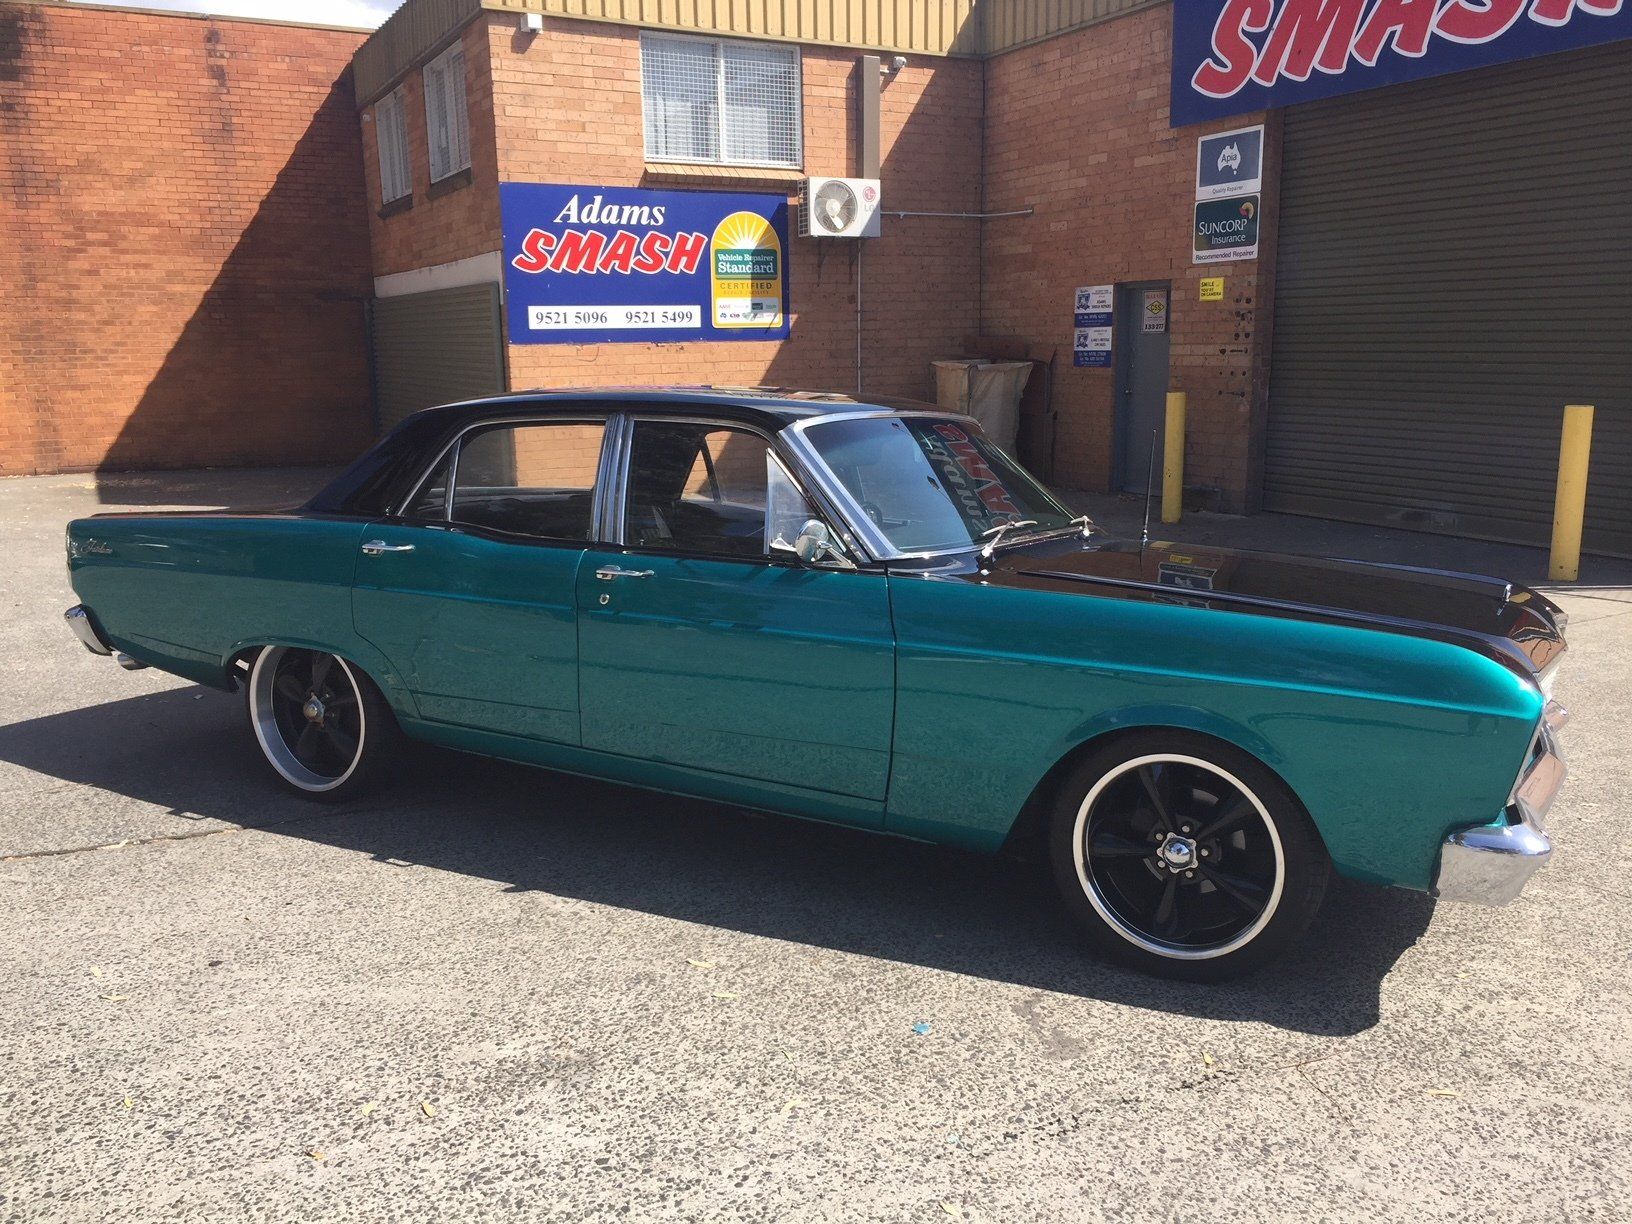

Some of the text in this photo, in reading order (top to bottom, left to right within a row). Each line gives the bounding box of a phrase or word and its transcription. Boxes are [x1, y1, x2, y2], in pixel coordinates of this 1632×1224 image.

[1221, 154, 1238, 163] Apia
[1211, 187, 1226, 195] Quality
[553, 194, 666, 226] Adams
[1198, 219, 1247, 235] SUNCORP
[1211, 234, 1246, 245] Insurance
[512, 227, 709, 275] SMASH
[1196, 251, 1231, 260] Recommended
[744, 254, 774, 262] Repairer
[717, 262, 774, 273] Standard
[535, 311, 693, 324] 9521 5096 9521 5499
